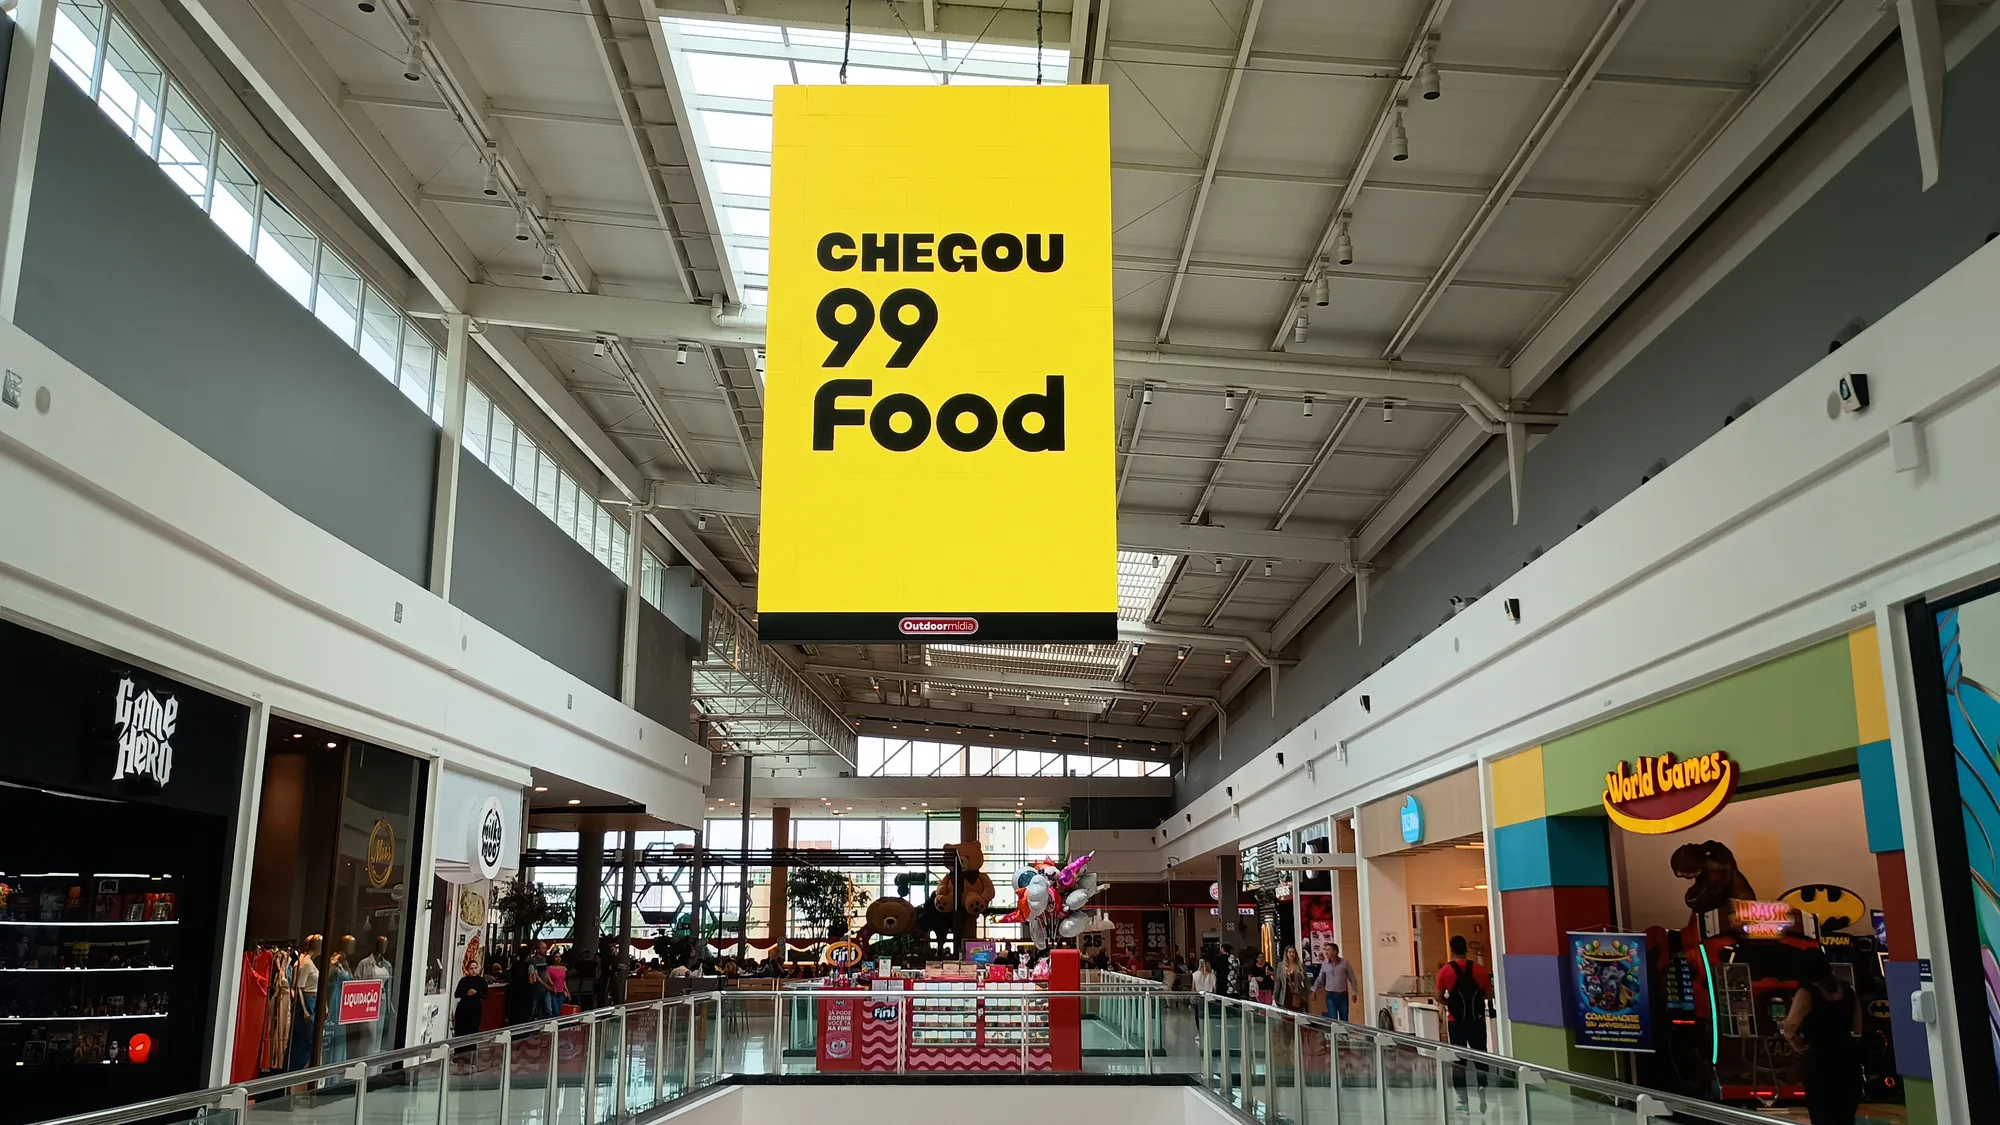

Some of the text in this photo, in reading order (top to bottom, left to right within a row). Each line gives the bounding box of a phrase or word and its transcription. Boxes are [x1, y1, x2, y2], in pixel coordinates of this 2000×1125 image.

[816, 232, 1065, 273] CHEGOU
[815, 287, 939, 369] 99
[812, 374, 1066, 453] Food
[1605, 752, 1721, 804] World Games
[1733, 901, 1790, 923] JURASSIC
[1751, 922, 1776, 936] PARK
[344, 989, 378, 1008] LIQUIDAÇÃO
[1585, 1012, 1640, 1023] COMEMORE
